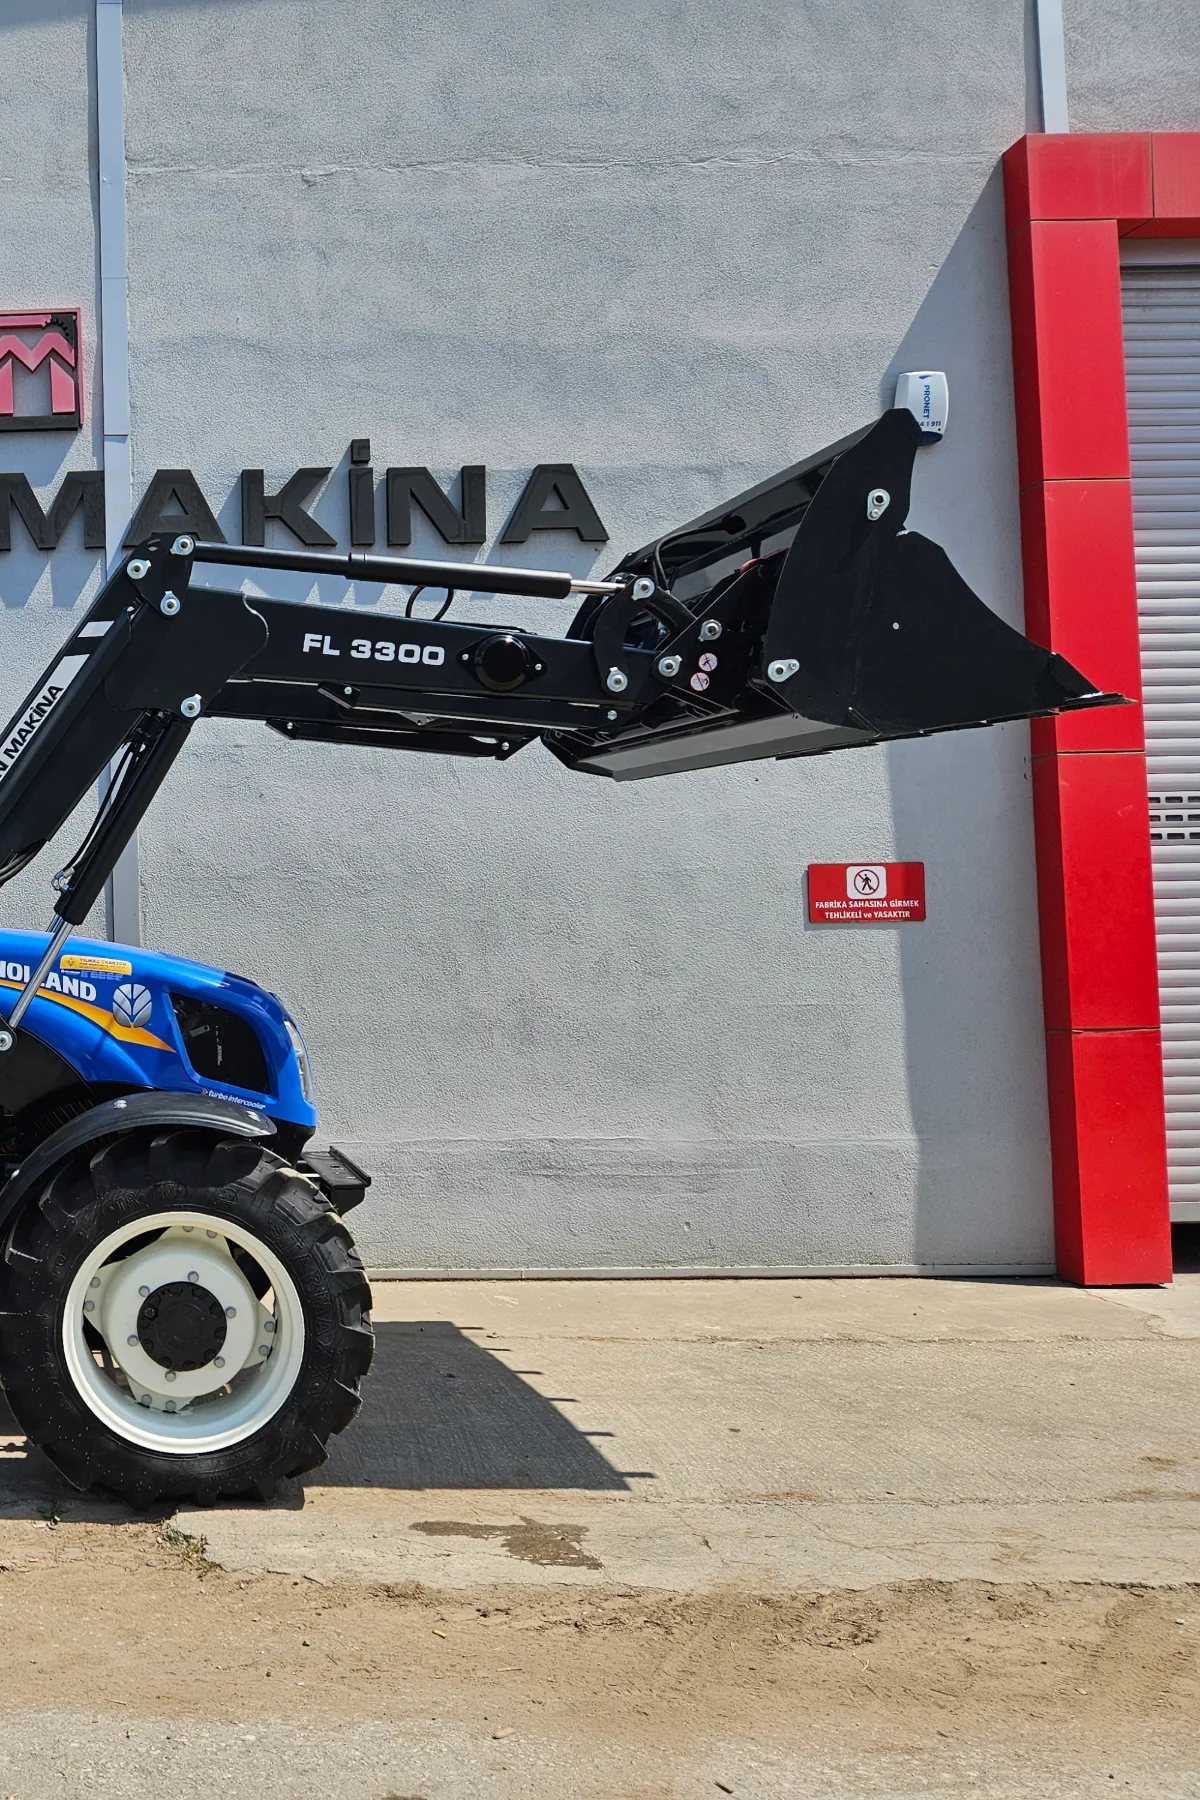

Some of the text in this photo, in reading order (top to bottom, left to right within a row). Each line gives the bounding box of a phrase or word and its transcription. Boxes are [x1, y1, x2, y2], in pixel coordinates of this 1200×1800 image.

[923, 384, 931, 419] PRONET
[302, 633, 446, 666] FL 3300
[3, 685, 64, 760] MAKİNA
[815, 899, 920, 909] FABRİKA SAHASINA GİRMEK
[825, 910, 862, 919] TEHLİKELİ
[208, 1089, 266, 1110] turbo intercooler
